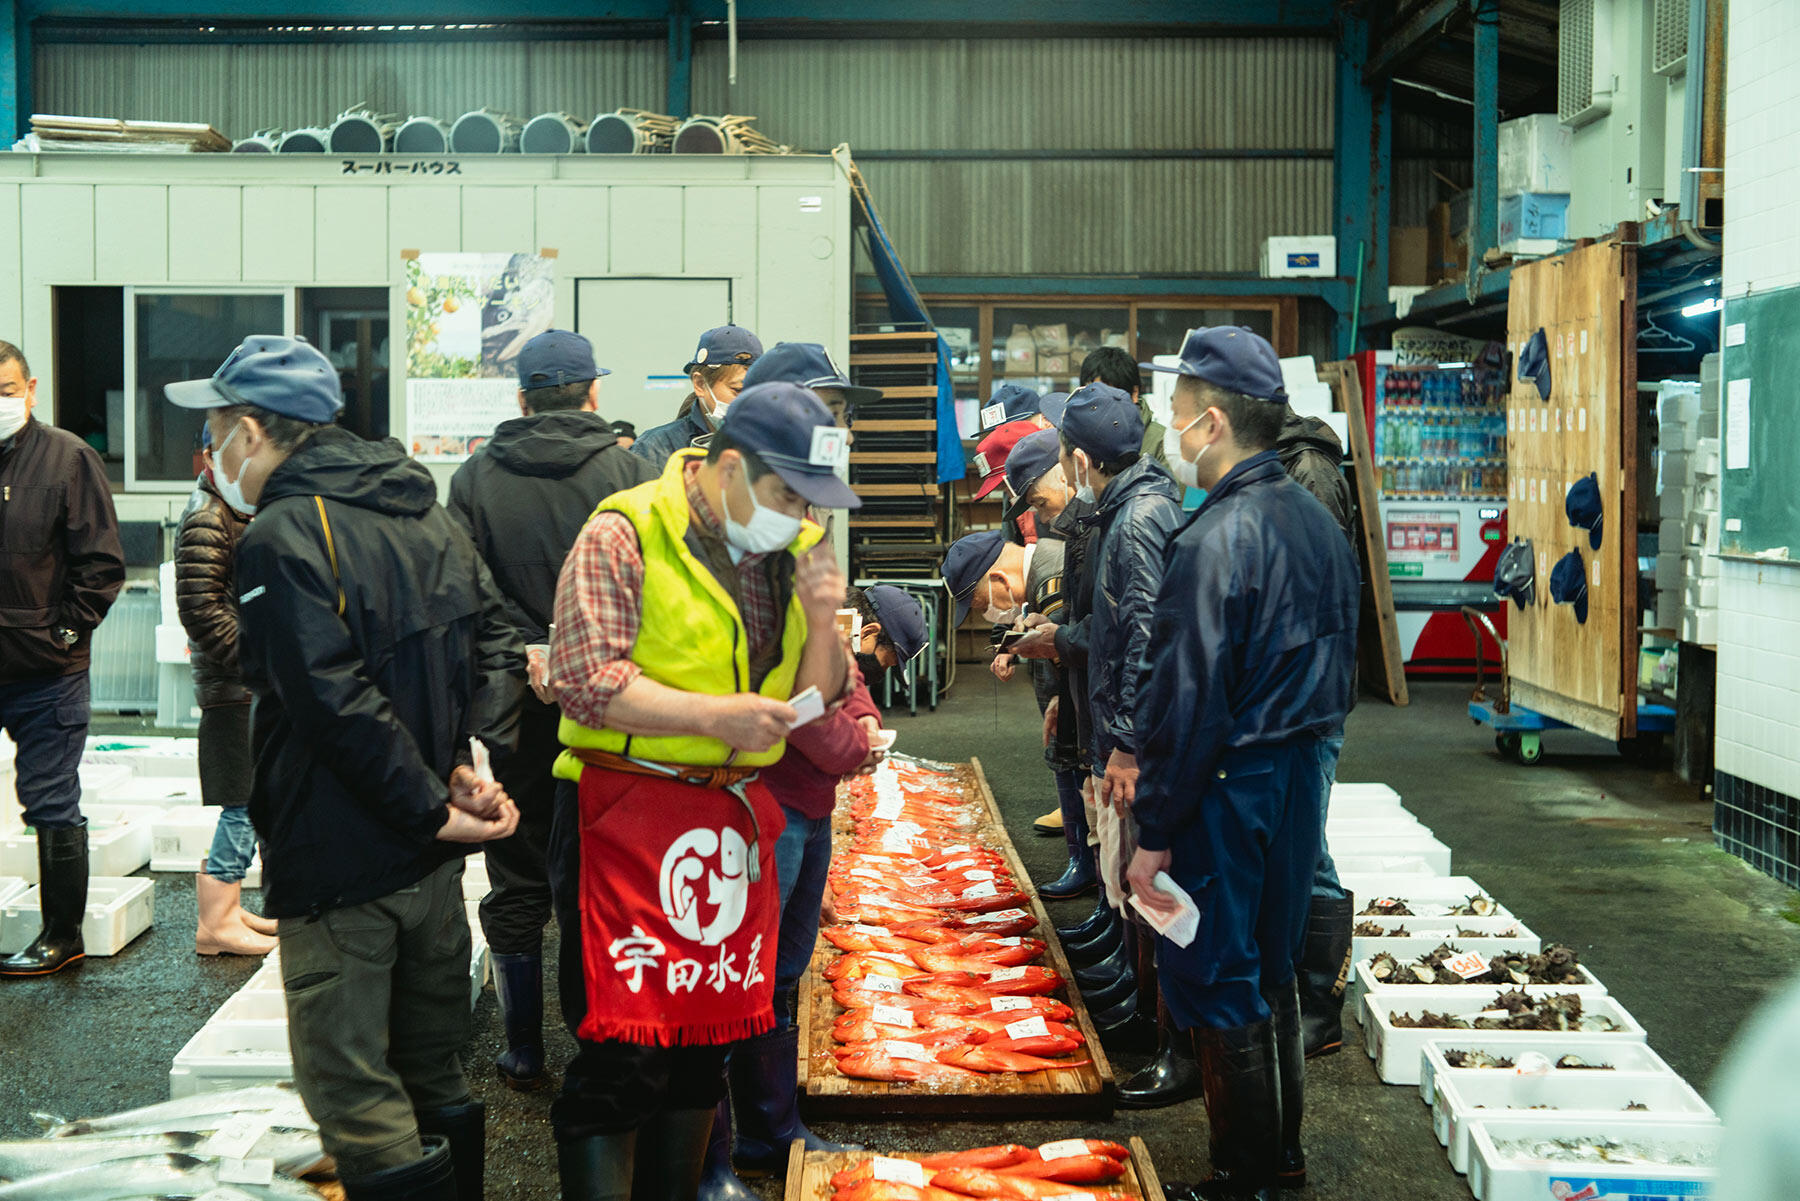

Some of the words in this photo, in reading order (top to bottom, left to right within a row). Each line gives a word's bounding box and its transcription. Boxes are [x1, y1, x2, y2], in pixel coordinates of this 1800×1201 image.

[341, 160, 462, 175] スーパーハウス
[608, 924, 765, 996] 宇田水産
